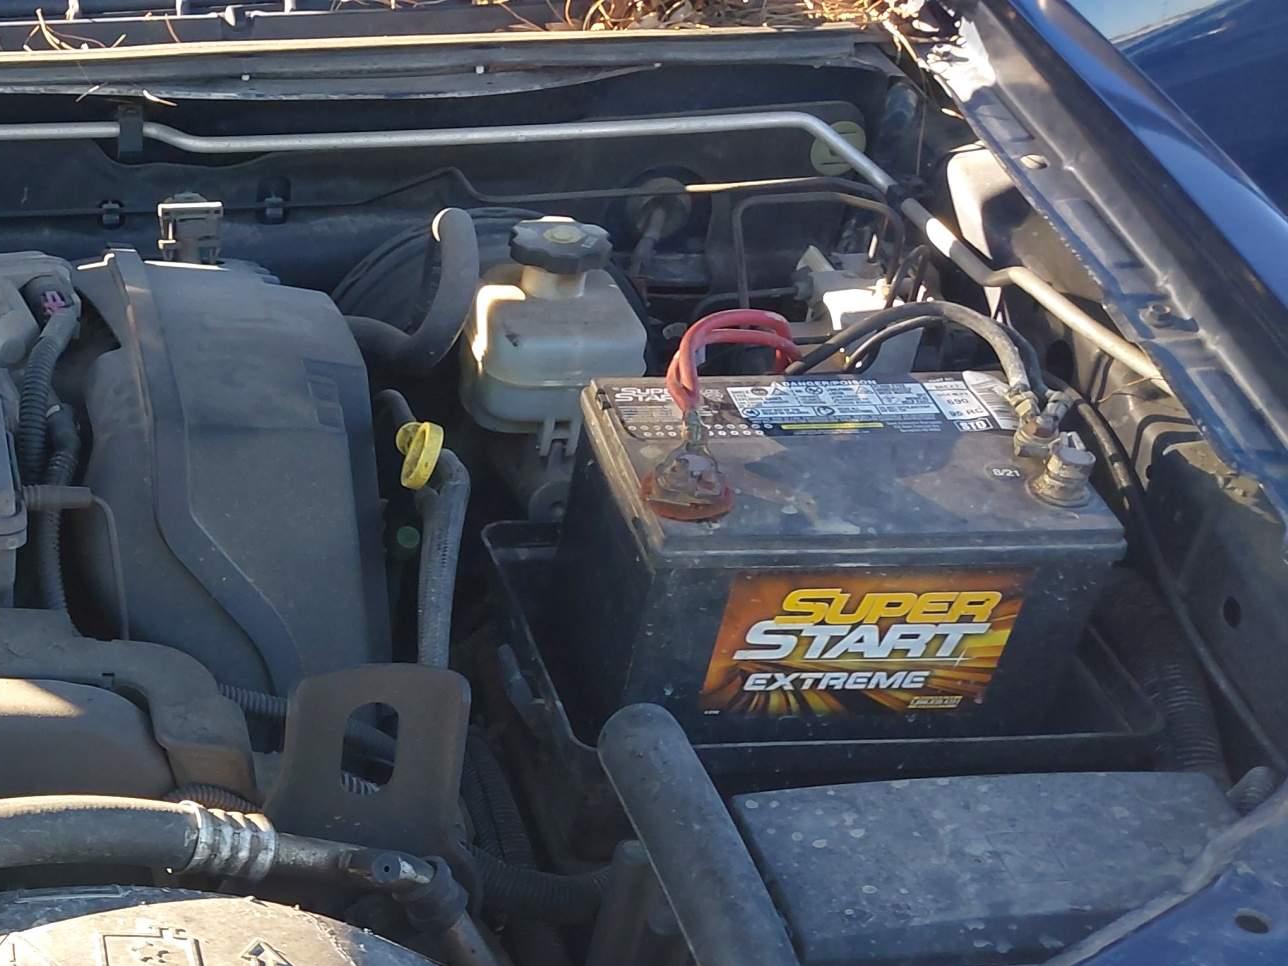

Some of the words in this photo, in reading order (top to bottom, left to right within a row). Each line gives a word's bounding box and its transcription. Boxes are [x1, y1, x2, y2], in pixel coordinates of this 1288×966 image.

[775, 589, 1001, 624] SUPER
[733, 621, 991, 659] START
[743, 670, 931, 691] EXTREME
